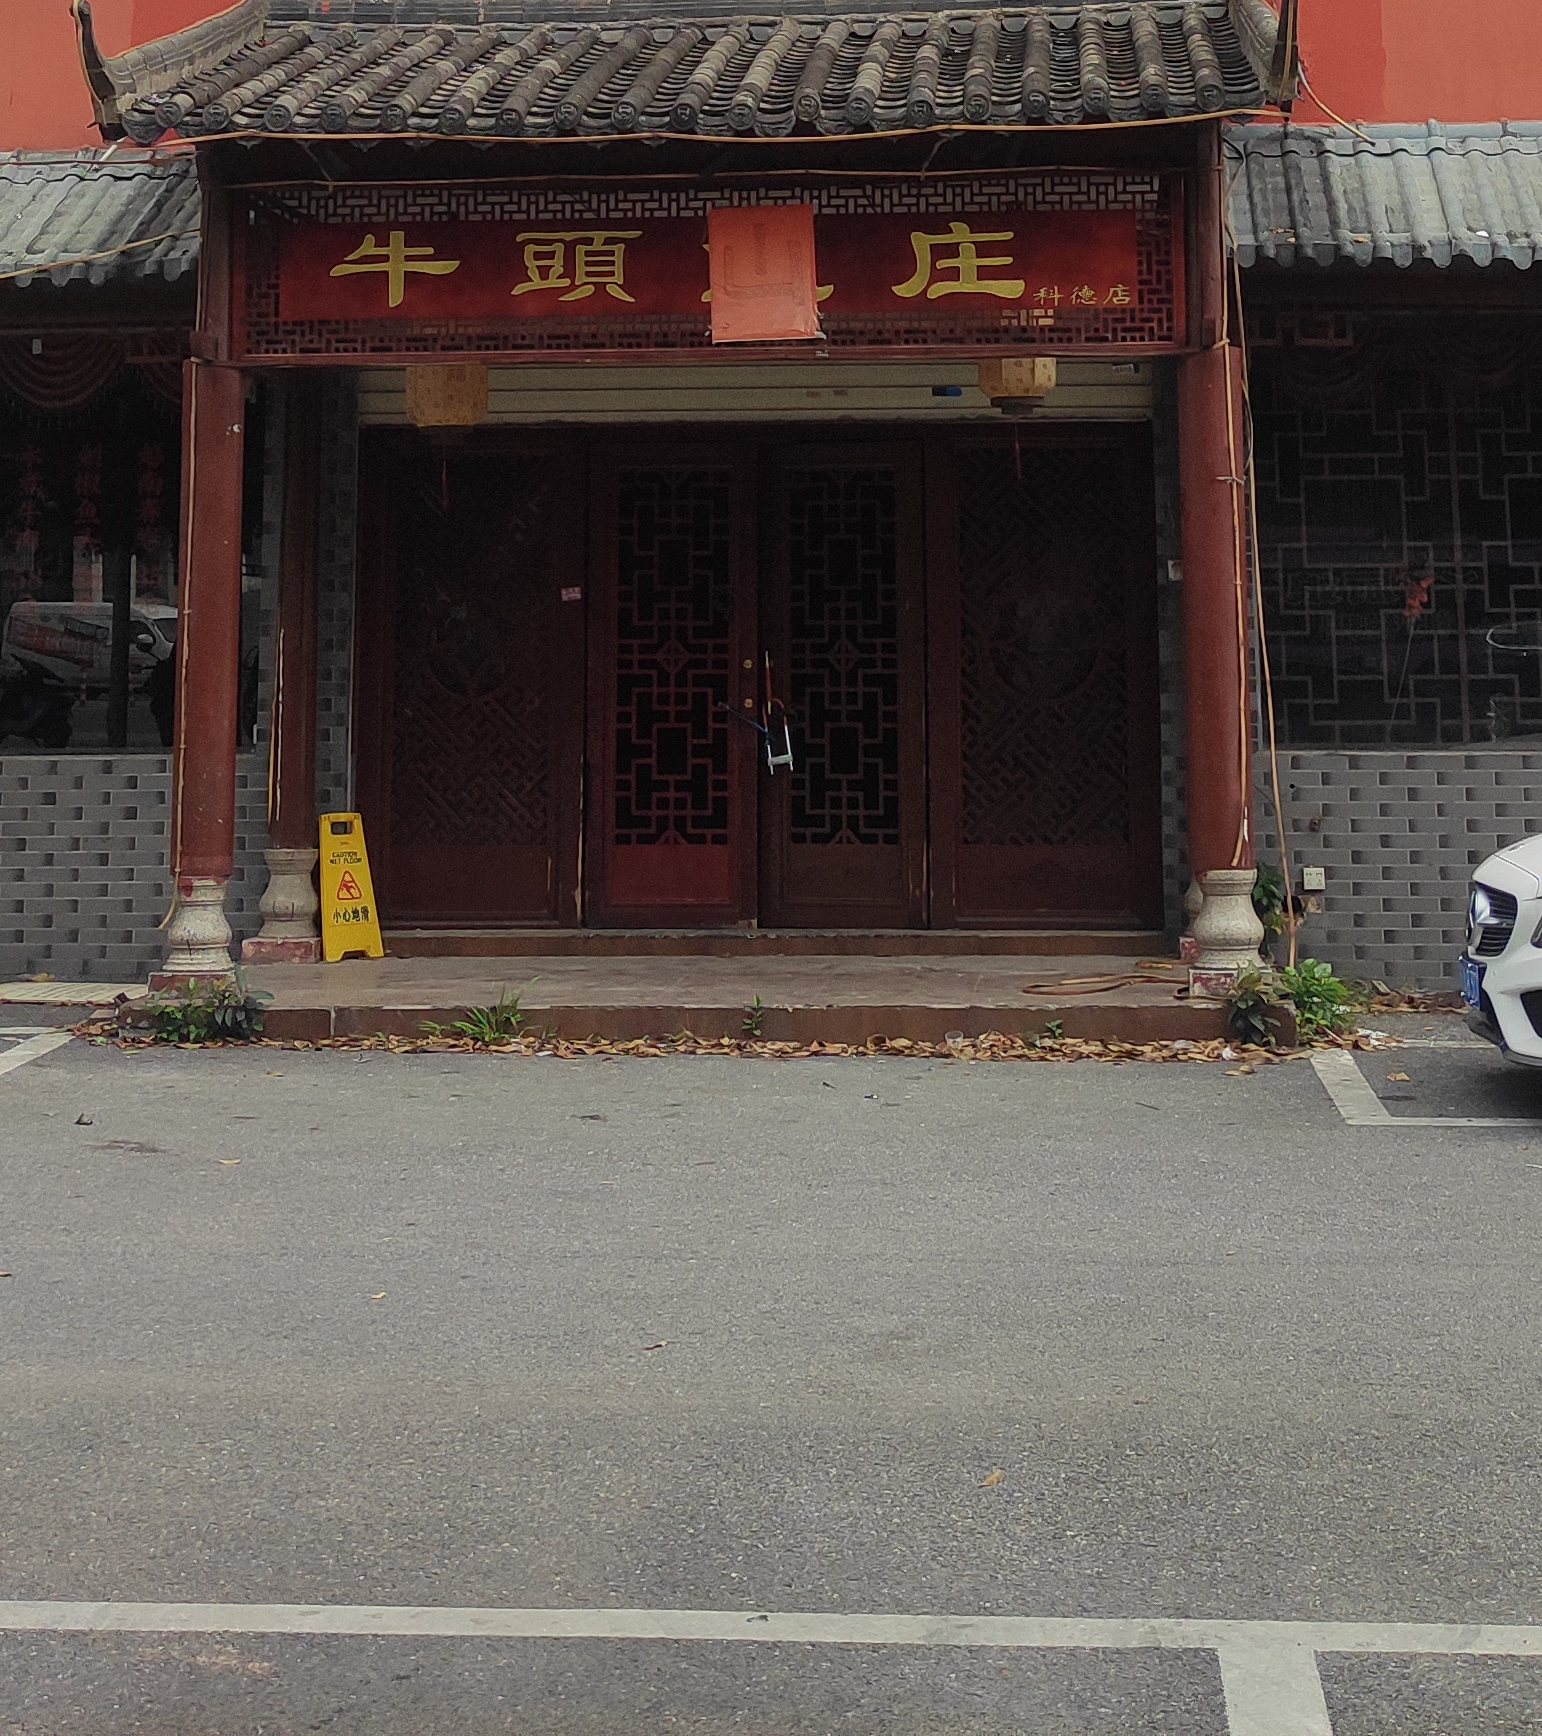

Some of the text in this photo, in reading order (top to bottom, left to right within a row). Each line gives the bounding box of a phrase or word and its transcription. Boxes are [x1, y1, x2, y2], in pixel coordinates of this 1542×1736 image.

[329, 220, 1027, 309] 牛頭庄
[1032, 283, 1131, 307] 科德店
[332, 904, 370, 924] 小心地滑
